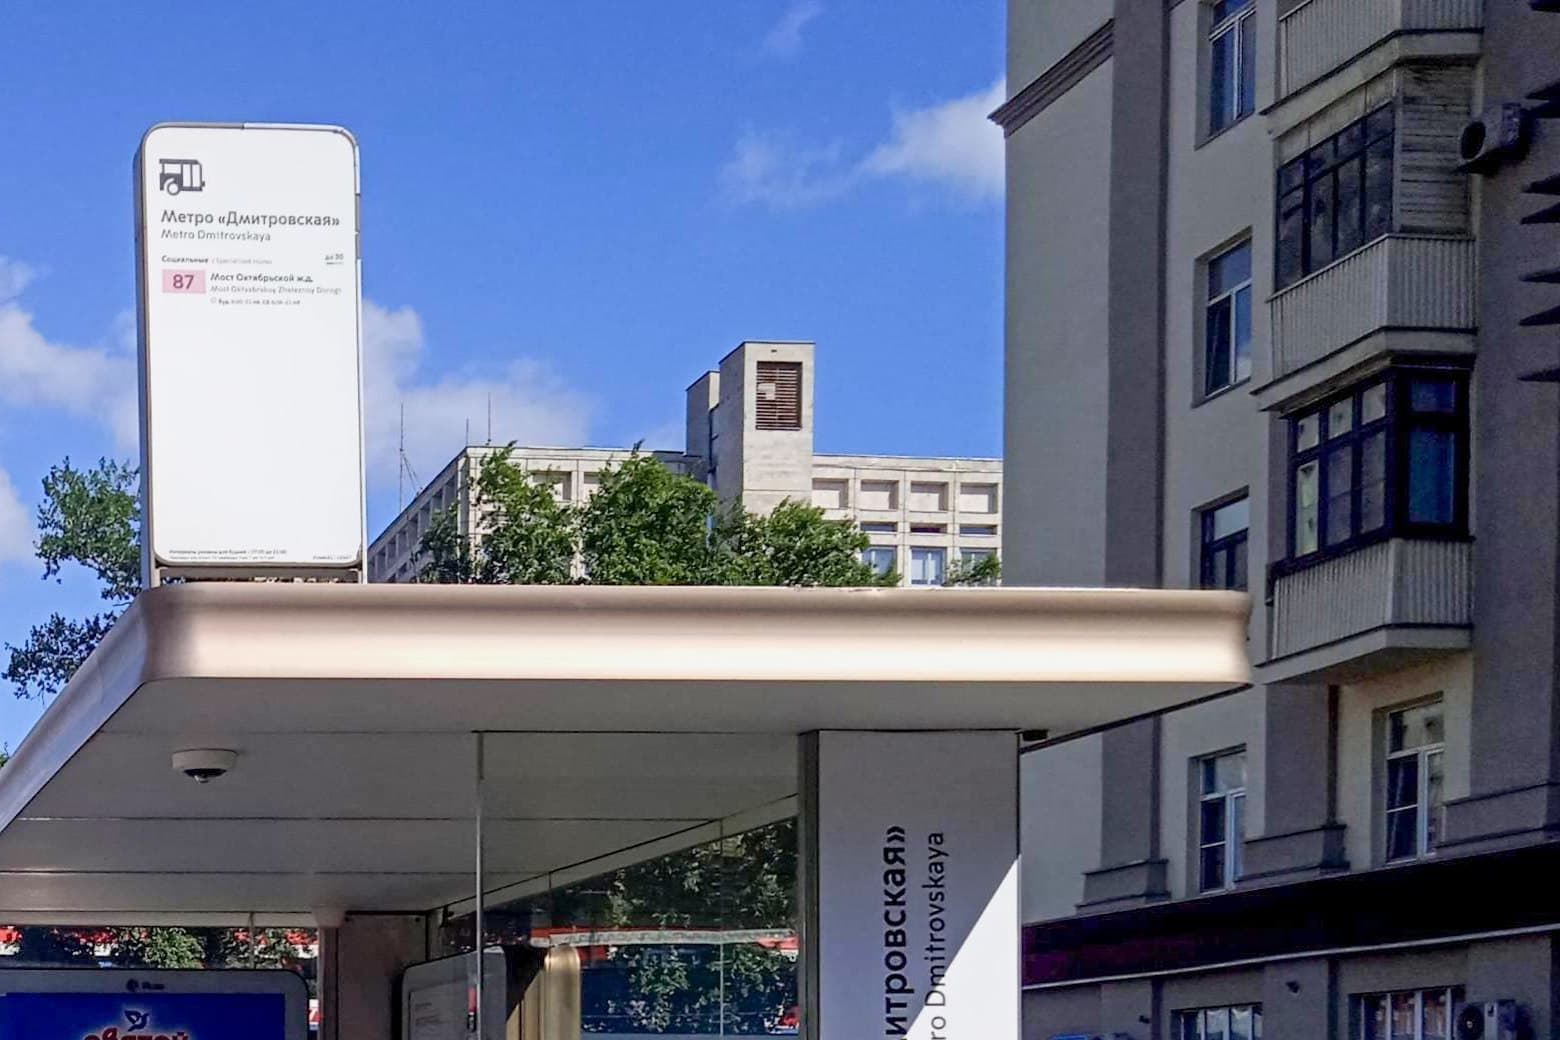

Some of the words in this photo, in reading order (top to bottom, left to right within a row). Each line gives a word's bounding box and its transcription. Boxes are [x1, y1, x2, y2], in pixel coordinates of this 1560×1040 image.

[160, 209, 214, 226] Метро
[218, 211, 340, 228] «Дмитровская»
[160, 229, 195, 239] Metro
[197, 230, 271, 242] Dmitrovskaya
[172, 273, 195, 289] 87
[921, 832, 950, 1007] Dmitrovskaya
